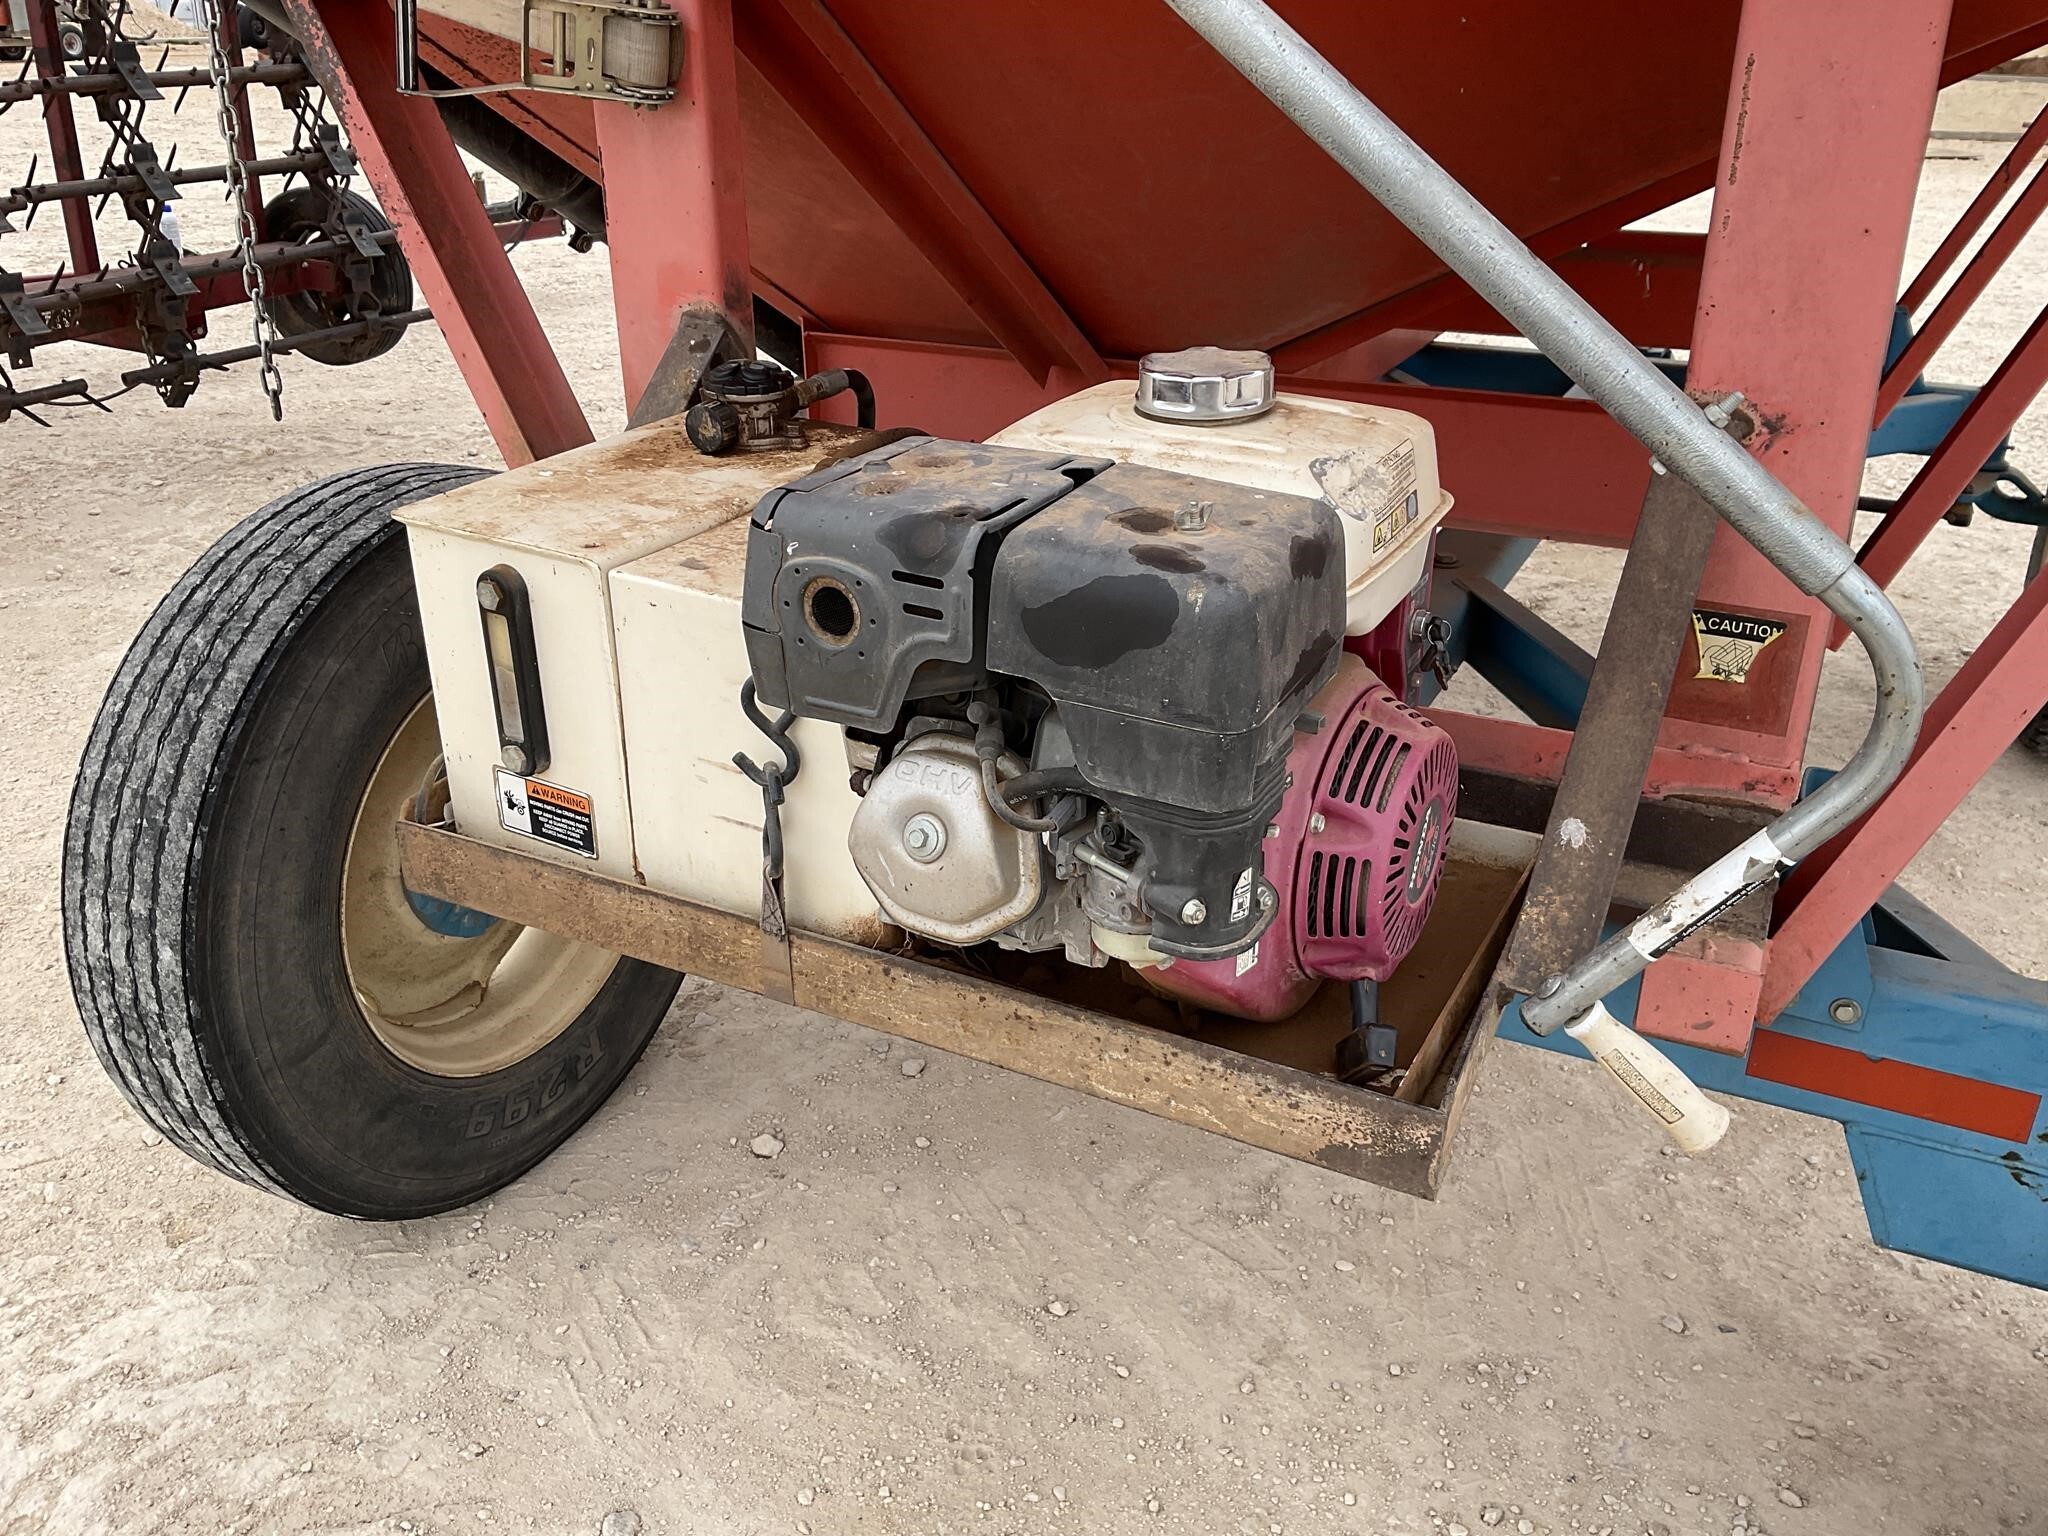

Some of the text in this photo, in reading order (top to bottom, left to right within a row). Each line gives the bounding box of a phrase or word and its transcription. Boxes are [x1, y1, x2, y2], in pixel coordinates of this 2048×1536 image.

[894, 759, 973, 796] OHV
[540, 787, 586, 811] WARNING
[1408, 806, 1432, 888] HONDA
